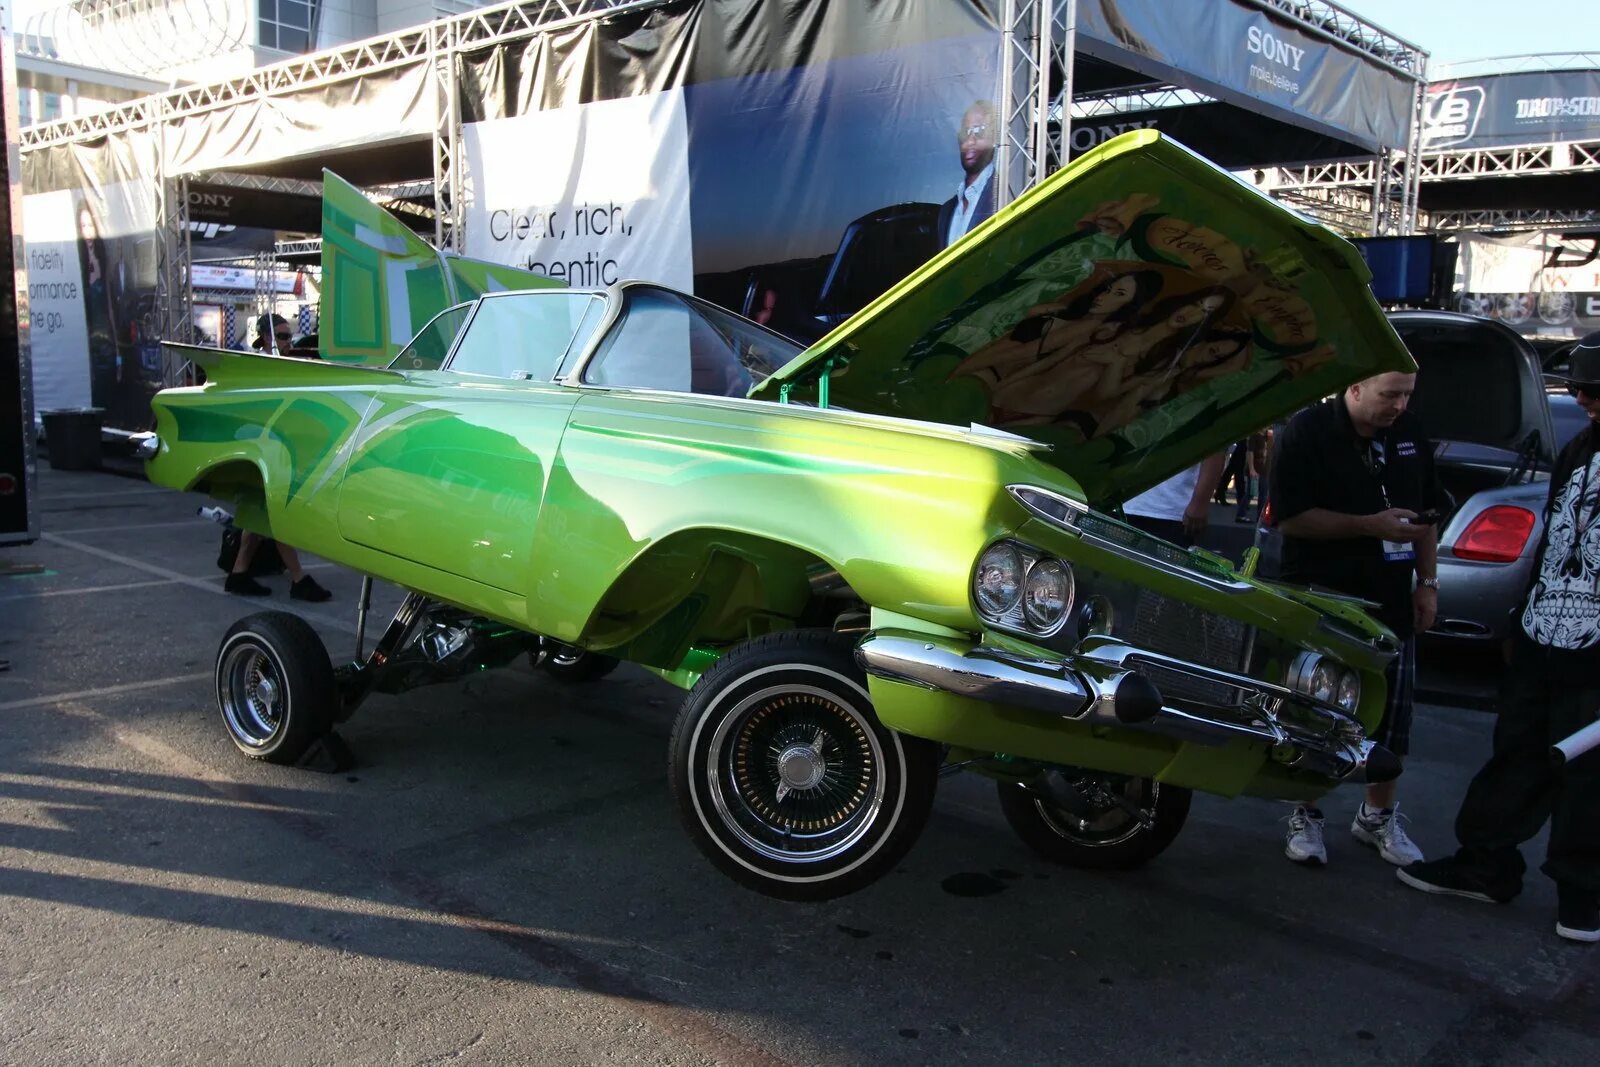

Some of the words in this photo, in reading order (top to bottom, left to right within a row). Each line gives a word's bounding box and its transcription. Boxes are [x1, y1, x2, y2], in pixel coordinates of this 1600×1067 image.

[1247, 26, 1305, 72] SONY
[187, 191, 234, 208] ONY
[575, 200, 633, 237] rich,
[31, 248, 65, 274] fidelity
[516, 251, 619, 288] hentic
[29, 281, 77, 300] ormance
[29, 307, 45, 329] he
[46, 311, 65, 334] go.
